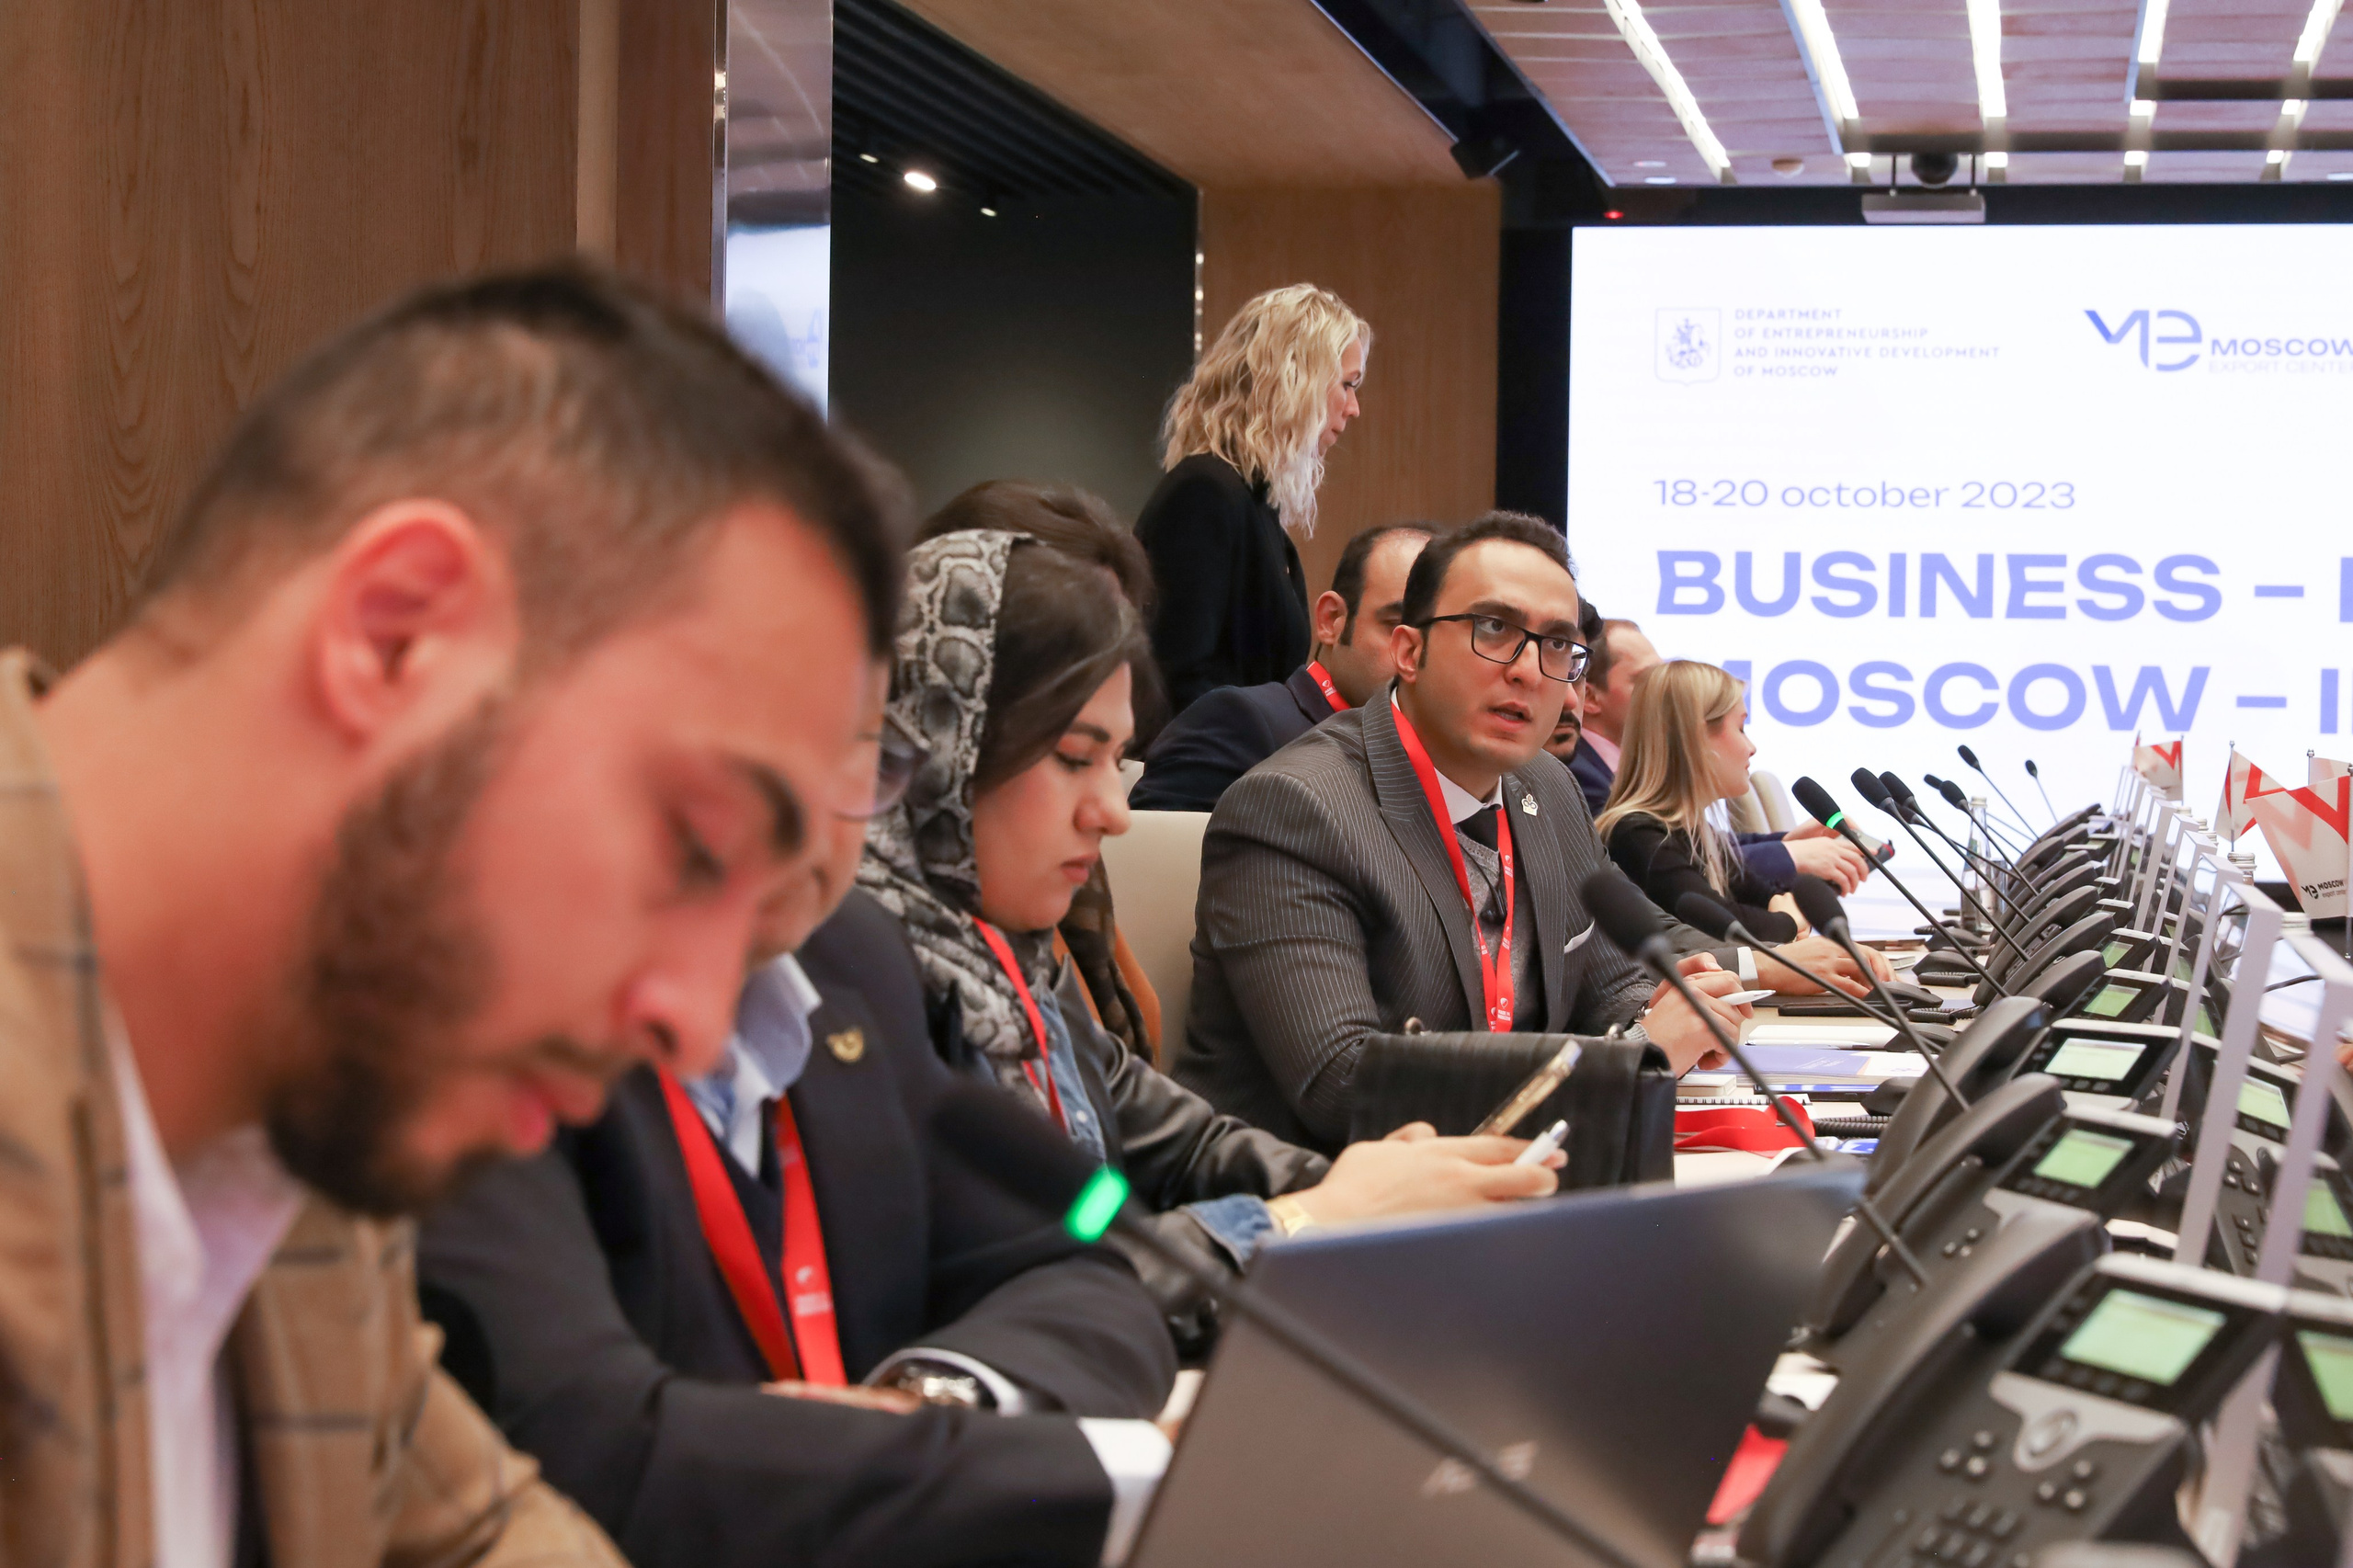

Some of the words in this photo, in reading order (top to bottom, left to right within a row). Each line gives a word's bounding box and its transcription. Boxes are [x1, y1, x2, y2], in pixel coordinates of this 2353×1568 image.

[1734, 308, 1842, 321] DEPARTMENT
[1733, 327, 1756, 339] OF
[1762, 327, 1928, 339] ENTREPRENEURSHIP
[1733, 347, 1768, 358] AND
[1775, 347, 1871, 358] INNOVATIVE
[1879, 347, 2000, 358] DEVELOPMENT
[2211, 338, 2353, 357] MOSCOW
[1733, 366, 1755, 377] OF
[1762, 365, 1838, 377] MOSCOW
[2208, 360, 2279, 373] EXPORT
[2285, 360, 2353, 373] CENTE
[1654, 479, 1768, 507] 18-20
[1780, 480, 1949, 508] october
[1961, 481, 2075, 509] 2023
[1655, 550, 2222, 623] BUSINESS
[1722, 660, 2211, 733] OSCOW
[2317, 879, 2344, 891] MOSCOW
